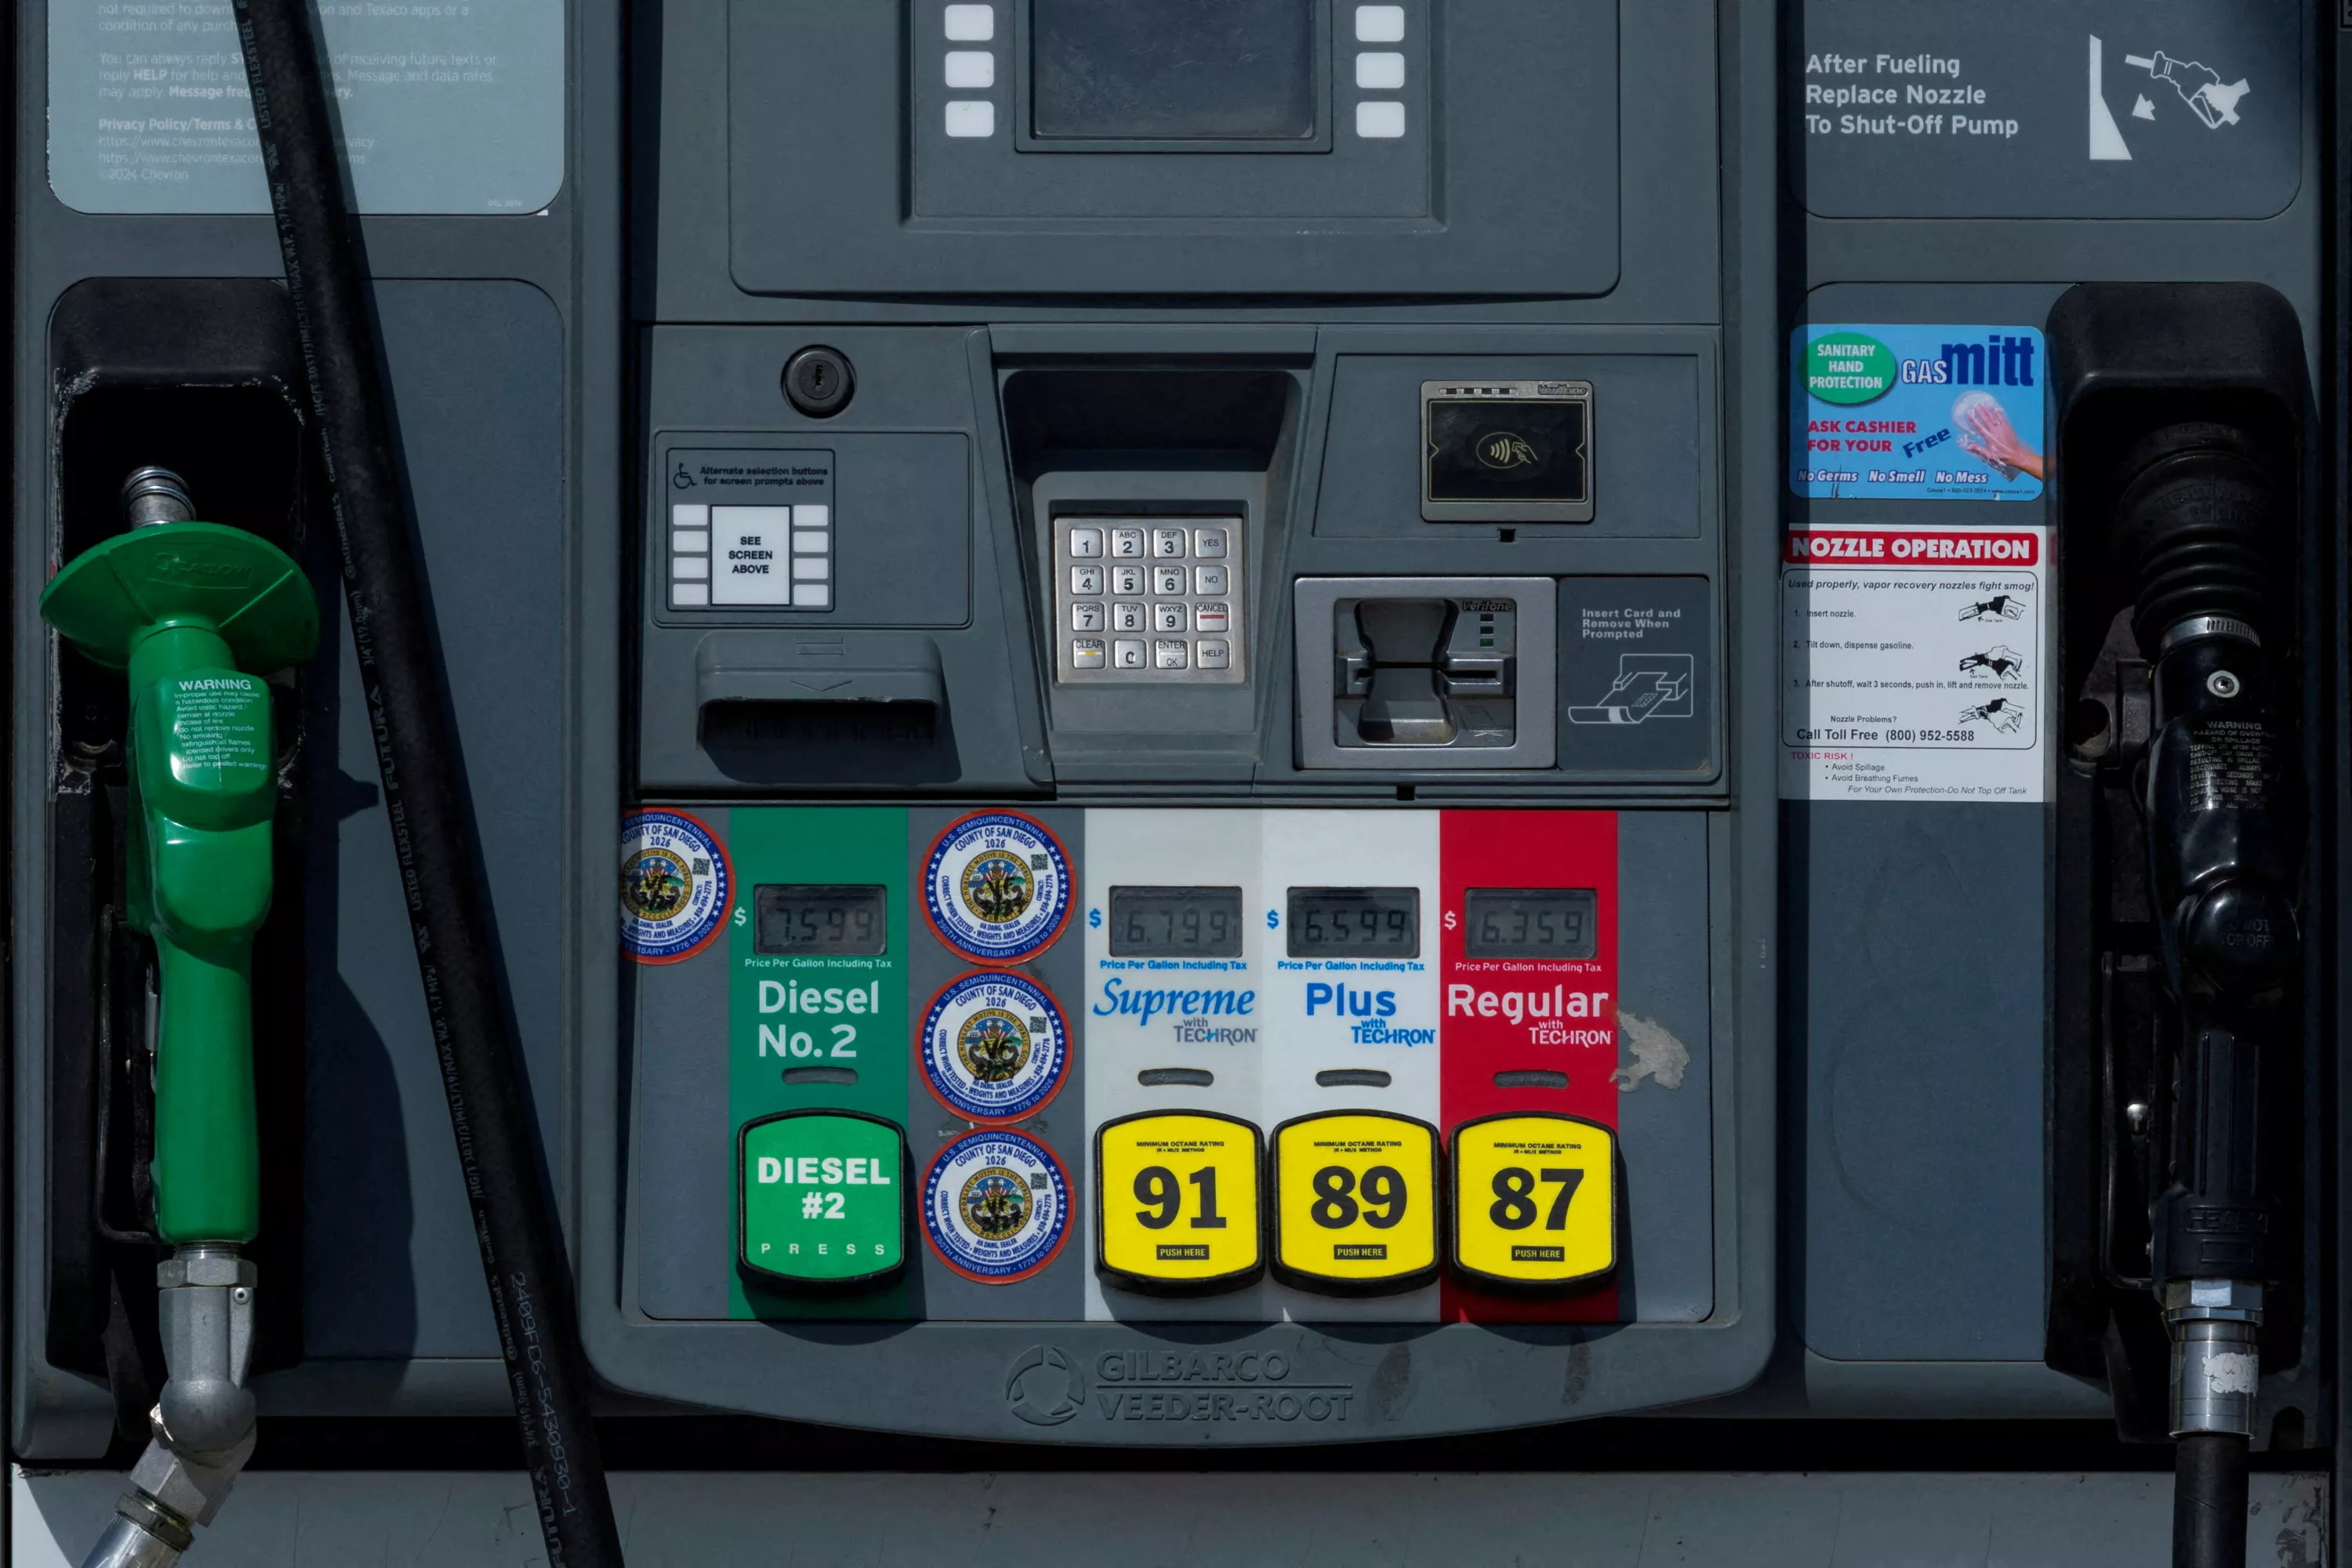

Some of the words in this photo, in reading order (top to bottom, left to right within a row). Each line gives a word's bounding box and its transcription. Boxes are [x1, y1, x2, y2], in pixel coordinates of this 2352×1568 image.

[100, 53, 121, 64] You
[126, 54, 147, 64] can
[151, 53, 192, 67] always
[197, 52, 228, 70] reply
[350, 53, 407, 71] receiving
[410, 53, 447, 66] future
[452, 53, 481, 65] texts
[1806, 54, 1867, 73] After
[1877, 54, 1959, 78] Fueling
[100, 70, 130, 82] reply
[134, 69, 167, 81] HELP
[171, 70, 188, 82] for
[192, 69, 218, 82] help
[349, 68, 401, 83] Message
[405, 69, 427, 81] and
[430, 71, 459, 82] data
[463, 70, 492, 82] rates
[1806, 85, 1897, 107] Replace
[1907, 85, 1985, 103] Nozzle
[100, 118, 145, 132] Privacy
[149, 118, 231, 132] Policy/Terms
[1805, 115, 1831, 133] To
[1841, 114, 1942, 134] Shut-Off
[1952, 115, 2018, 138] Pump
[141, 169, 188, 180] Chevron
[1817, 344, 1875, 356] SANITARY
[1829, 361, 1864, 372] HAND
[1808, 376, 1882, 390] PROTECTION
[1807, 421, 1842, 433] ASK
[1846, 421, 1917, 434] CASHIER
[1807, 440, 1841, 452] FOR
[1845, 440, 1892, 452] YOUR
[1902, 428, 1951, 459] Free
[755, 477, 793, 486] prompts
[740, 536, 760, 545] SEE
[1123, 541, 1133, 554] 2
[1164, 541, 1174, 554] 3
[1793, 537, 1884, 557] NOZZLE
[1892, 539, 2030, 559] OPERATION
[729, 550, 772, 560] SCREEN
[732, 564, 769, 573] ABOVE
[1788, 579, 1813, 589] Used
[1816, 580, 1860, 591] properly,
[1863, 581, 1891, 590] vapor
[1894, 581, 1936, 591] recovery
[1939, 581, 1976, 590] nozzles
[1979, 581, 2001, 591] fight
[2004, 582, 2034, 592] smog!
[1461, 601, 1512, 612] Verifone
[1583, 609, 1619, 620] Insert
[1624, 608, 1653, 620] Card
[1806, 609, 1828, 618] Insert
[1583, 619, 1631, 630] Remove
[1635, 619, 1668, 630] When
[1583, 629, 1642, 640] Prompted
[1844, 641, 1878, 651] dispense
[1880, 641, 1914, 651] gasoline.
[179, 680, 251, 691] WARNING
[1880, 681, 1914, 689] seconds,
[1916, 681, 1933, 691] push
[1936, 681, 1945, 690] in,
[2004, 681, 2029, 690] nozzle.
[2207, 721, 2262, 730] WARNING
[366, 684, 401, 790] FUTURA
[1797, 729, 1820, 740] Call
[1824, 729, 1846, 740] Toll
[1851, 730, 1878, 740] Free
[1886, 730, 1916, 743] (800)
[1920, 730, 1974, 742] 952-5588
[1855, 775, 1891, 783] Breathing
[956, 815, 1047, 844] SEMIQUINCENTENNIAL
[955, 829, 983, 851] COUNTY
[985, 828, 996, 837] OF
[996, 827, 1011, 837] SAN
[1013, 833, 1036, 849] DIEGO
[985, 839, 1006, 848] 2026
[733, 905, 746, 926] $
[776, 908, 873, 942] 7.599
[1127, 910, 1227, 943] 6.799
[1305, 909, 1406, 942] 6.599
[1482, 910, 1582, 944] 6.359
[937, 919, 956, 940] 250TH
[956, 938, 1015, 957] ANNIVERSARY
[1022, 939, 1040, 951] 1776
[1047, 914, 1061, 931] 2026
[828, 960, 872, 969] Including
[759, 980, 878, 1014] Diesel
[1093, 977, 1255, 1026] Supreme
[1306, 982, 1396, 1017] Plus
[1448, 984, 1609, 1025] Regular
[1361, 1018, 1386, 1028] with
[759, 1025, 822, 1058] No.
[831, 1024, 856, 1057] 2
[1174, 1025, 1256, 1046] TECHRON
[1529, 1027, 1611, 1047] TECHRON
[758, 1157, 890, 1184] DIESEL
[802, 1192, 844, 1218] #2
[1133, 1166, 1227, 1229] 91
[1311, 1166, 1407, 1229] 89
[1489, 1167, 1584, 1231] 87
[1096, 1350, 1290, 1381] GILBARCO
[1096, 1392, 1353, 1421] VEEDER-ROOT
